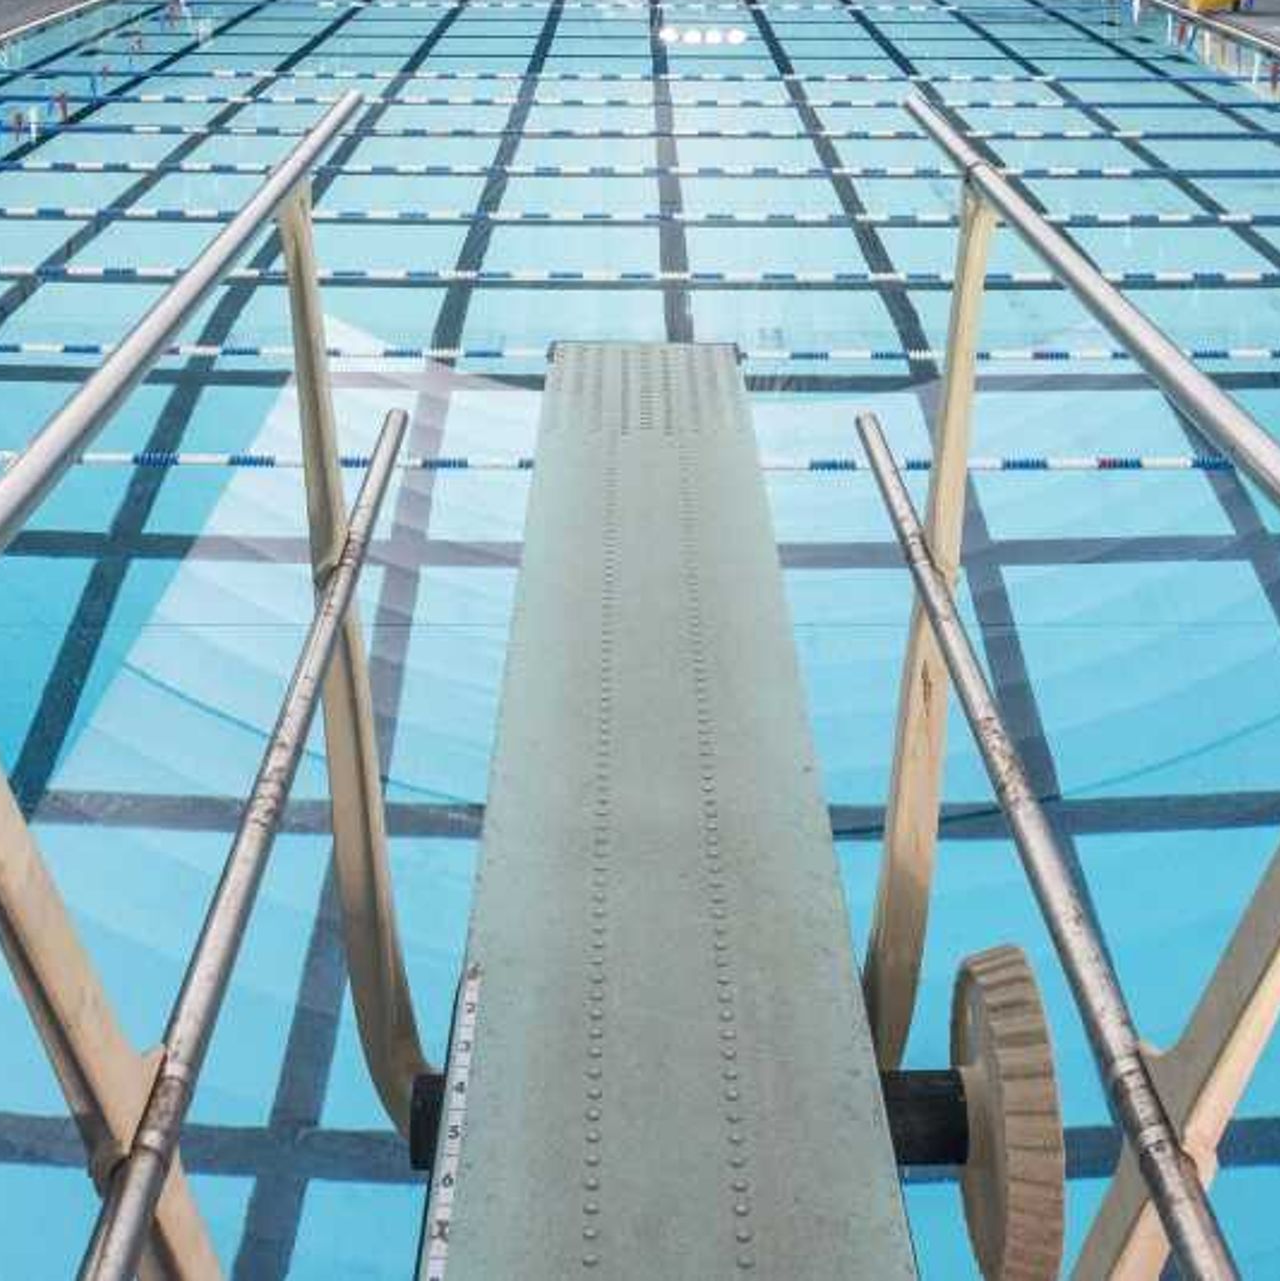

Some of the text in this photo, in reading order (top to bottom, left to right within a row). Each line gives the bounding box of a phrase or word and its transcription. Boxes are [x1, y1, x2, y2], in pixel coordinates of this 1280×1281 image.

[454, 1081, 466, 1094] 4
[447, 1124, 460, 1140] 5
[441, 1173, 454, 1188] 6
